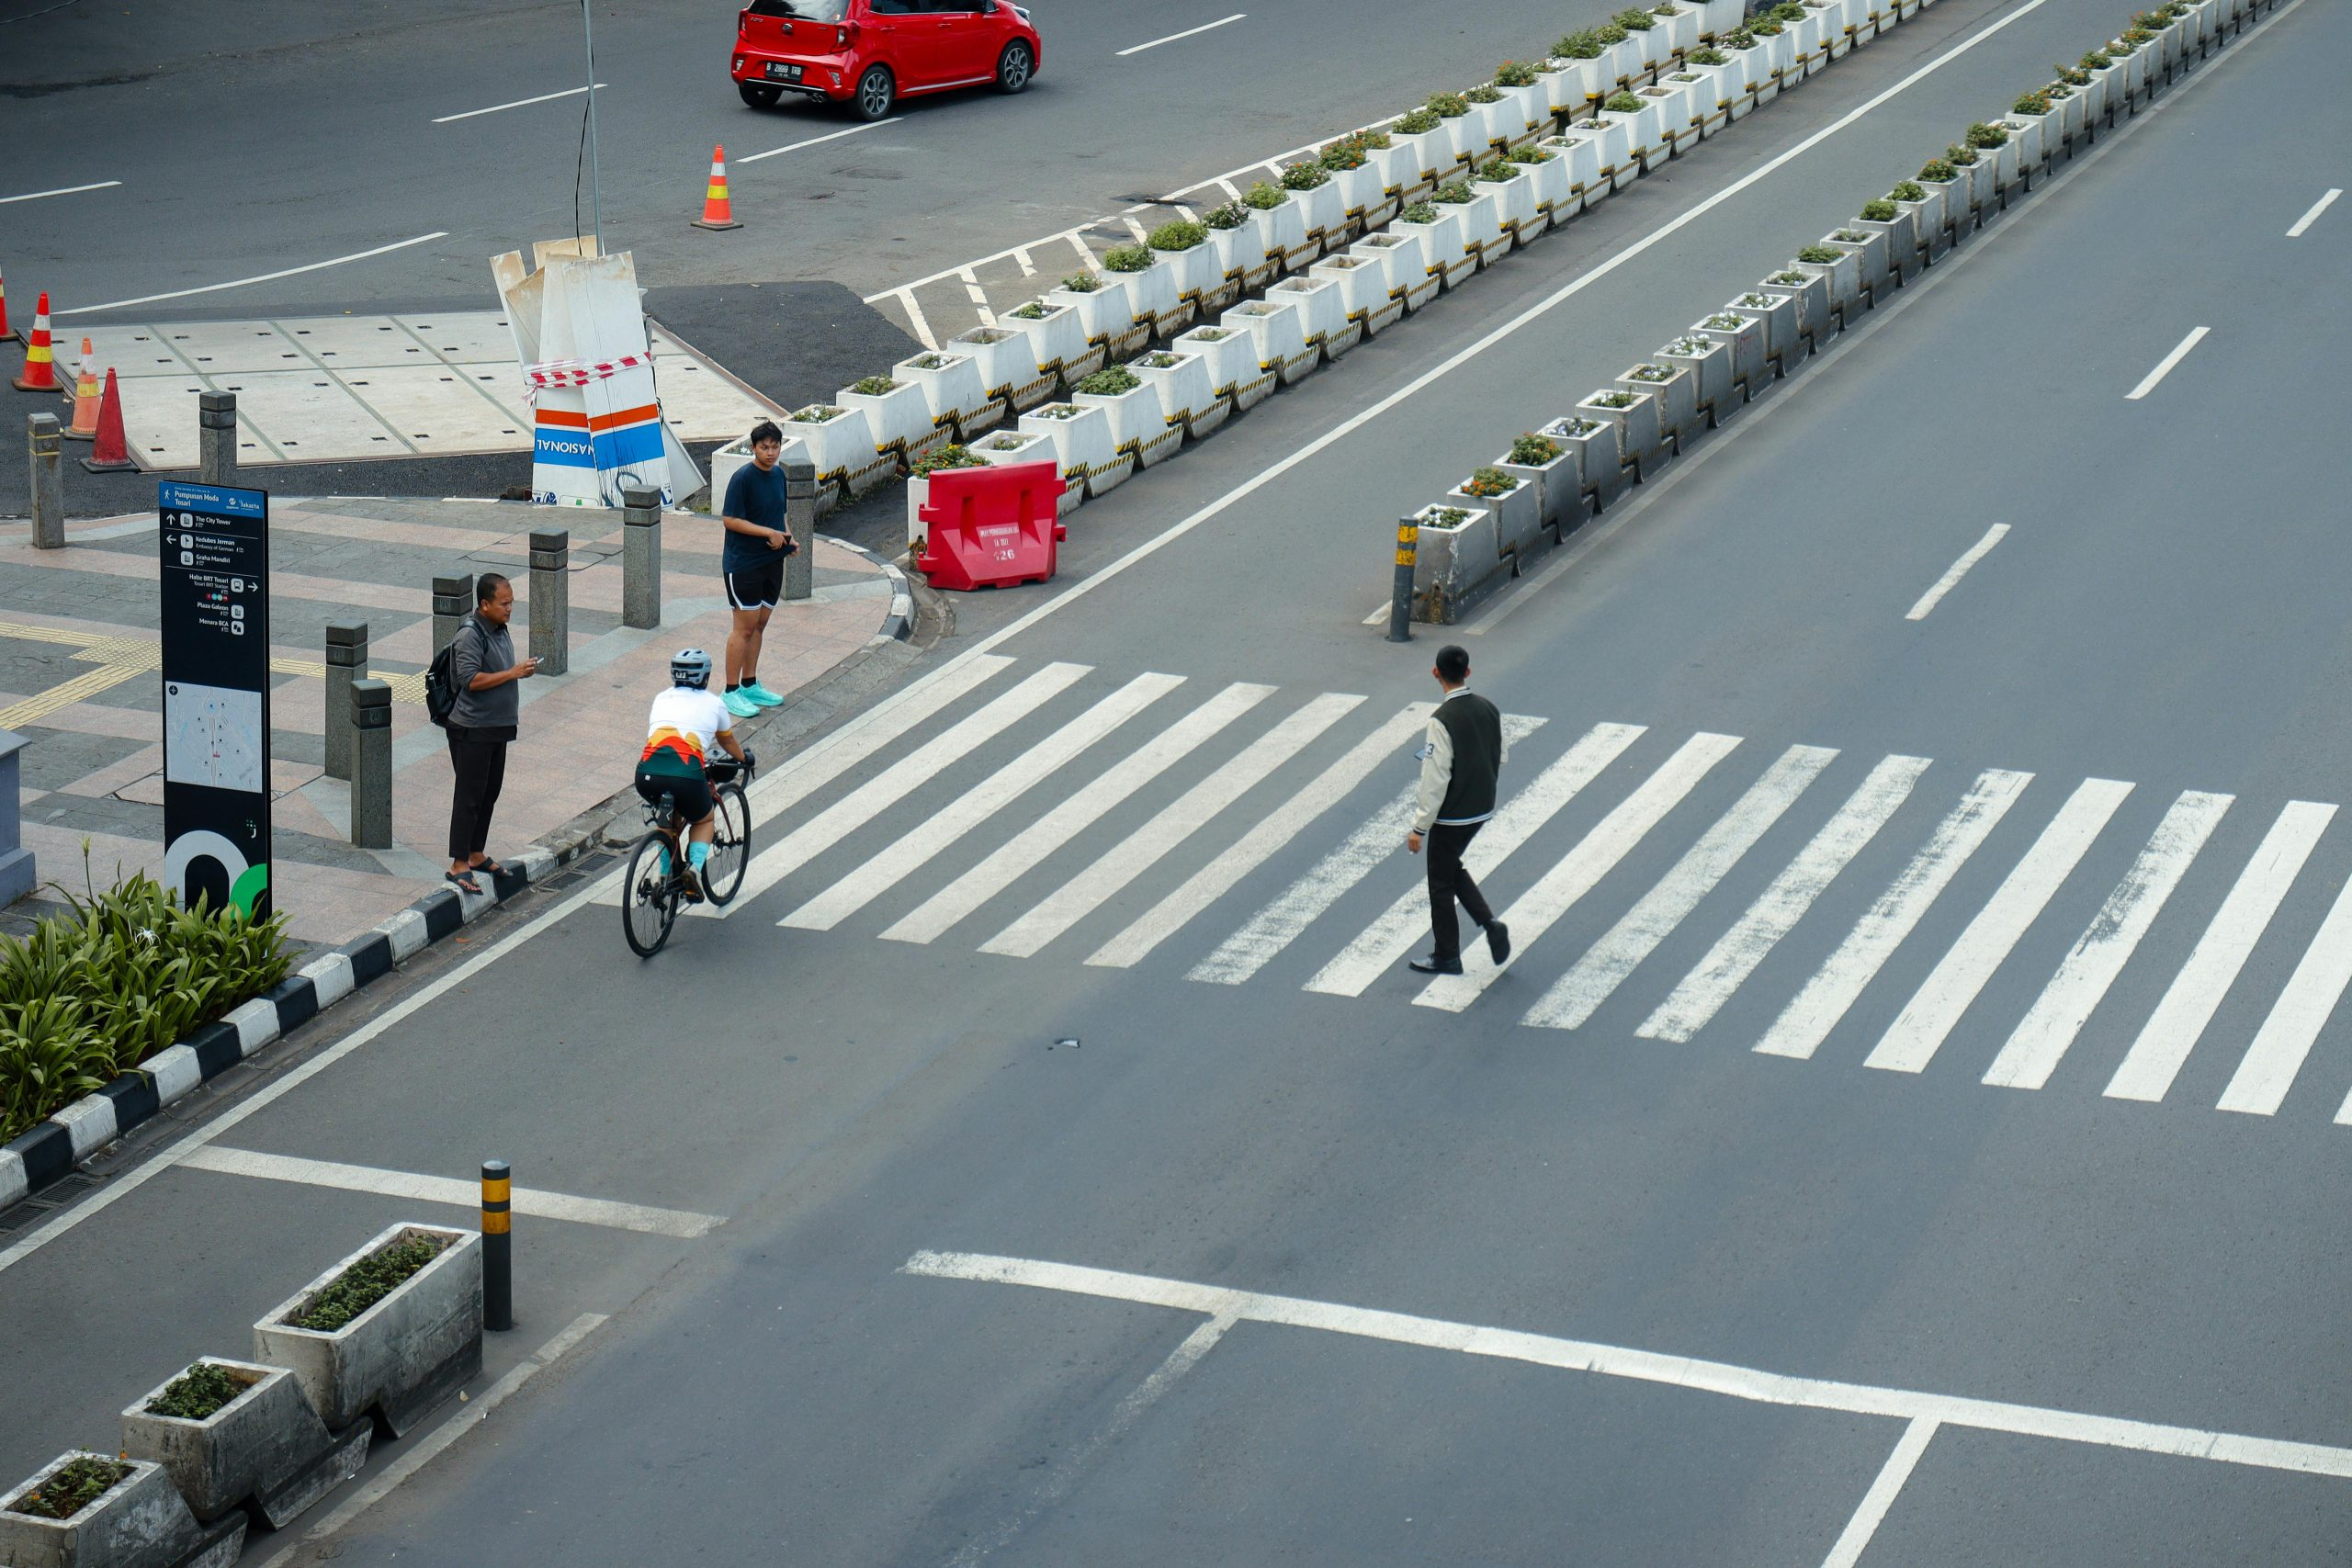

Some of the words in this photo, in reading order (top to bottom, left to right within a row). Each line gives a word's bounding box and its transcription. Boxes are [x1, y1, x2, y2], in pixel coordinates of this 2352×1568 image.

[766, 62, 772, 71] B
[537, 439, 594, 456] NASIONAL
[175, 490, 203, 501] Pumpunan
[203, 493, 220, 502] Moda
[175, 498, 191, 507] Tosari
[205, 516, 216, 525] City
[215, 517, 232, 525] Tower
[195, 536, 217, 545] Kedubes
[216, 538, 235, 547] Jerman
[210, 556, 231, 564] Mandiri
[188, 573, 203, 581] Halte
[213, 576, 229, 584] Tosari
[198, 617, 219, 626] Menara
